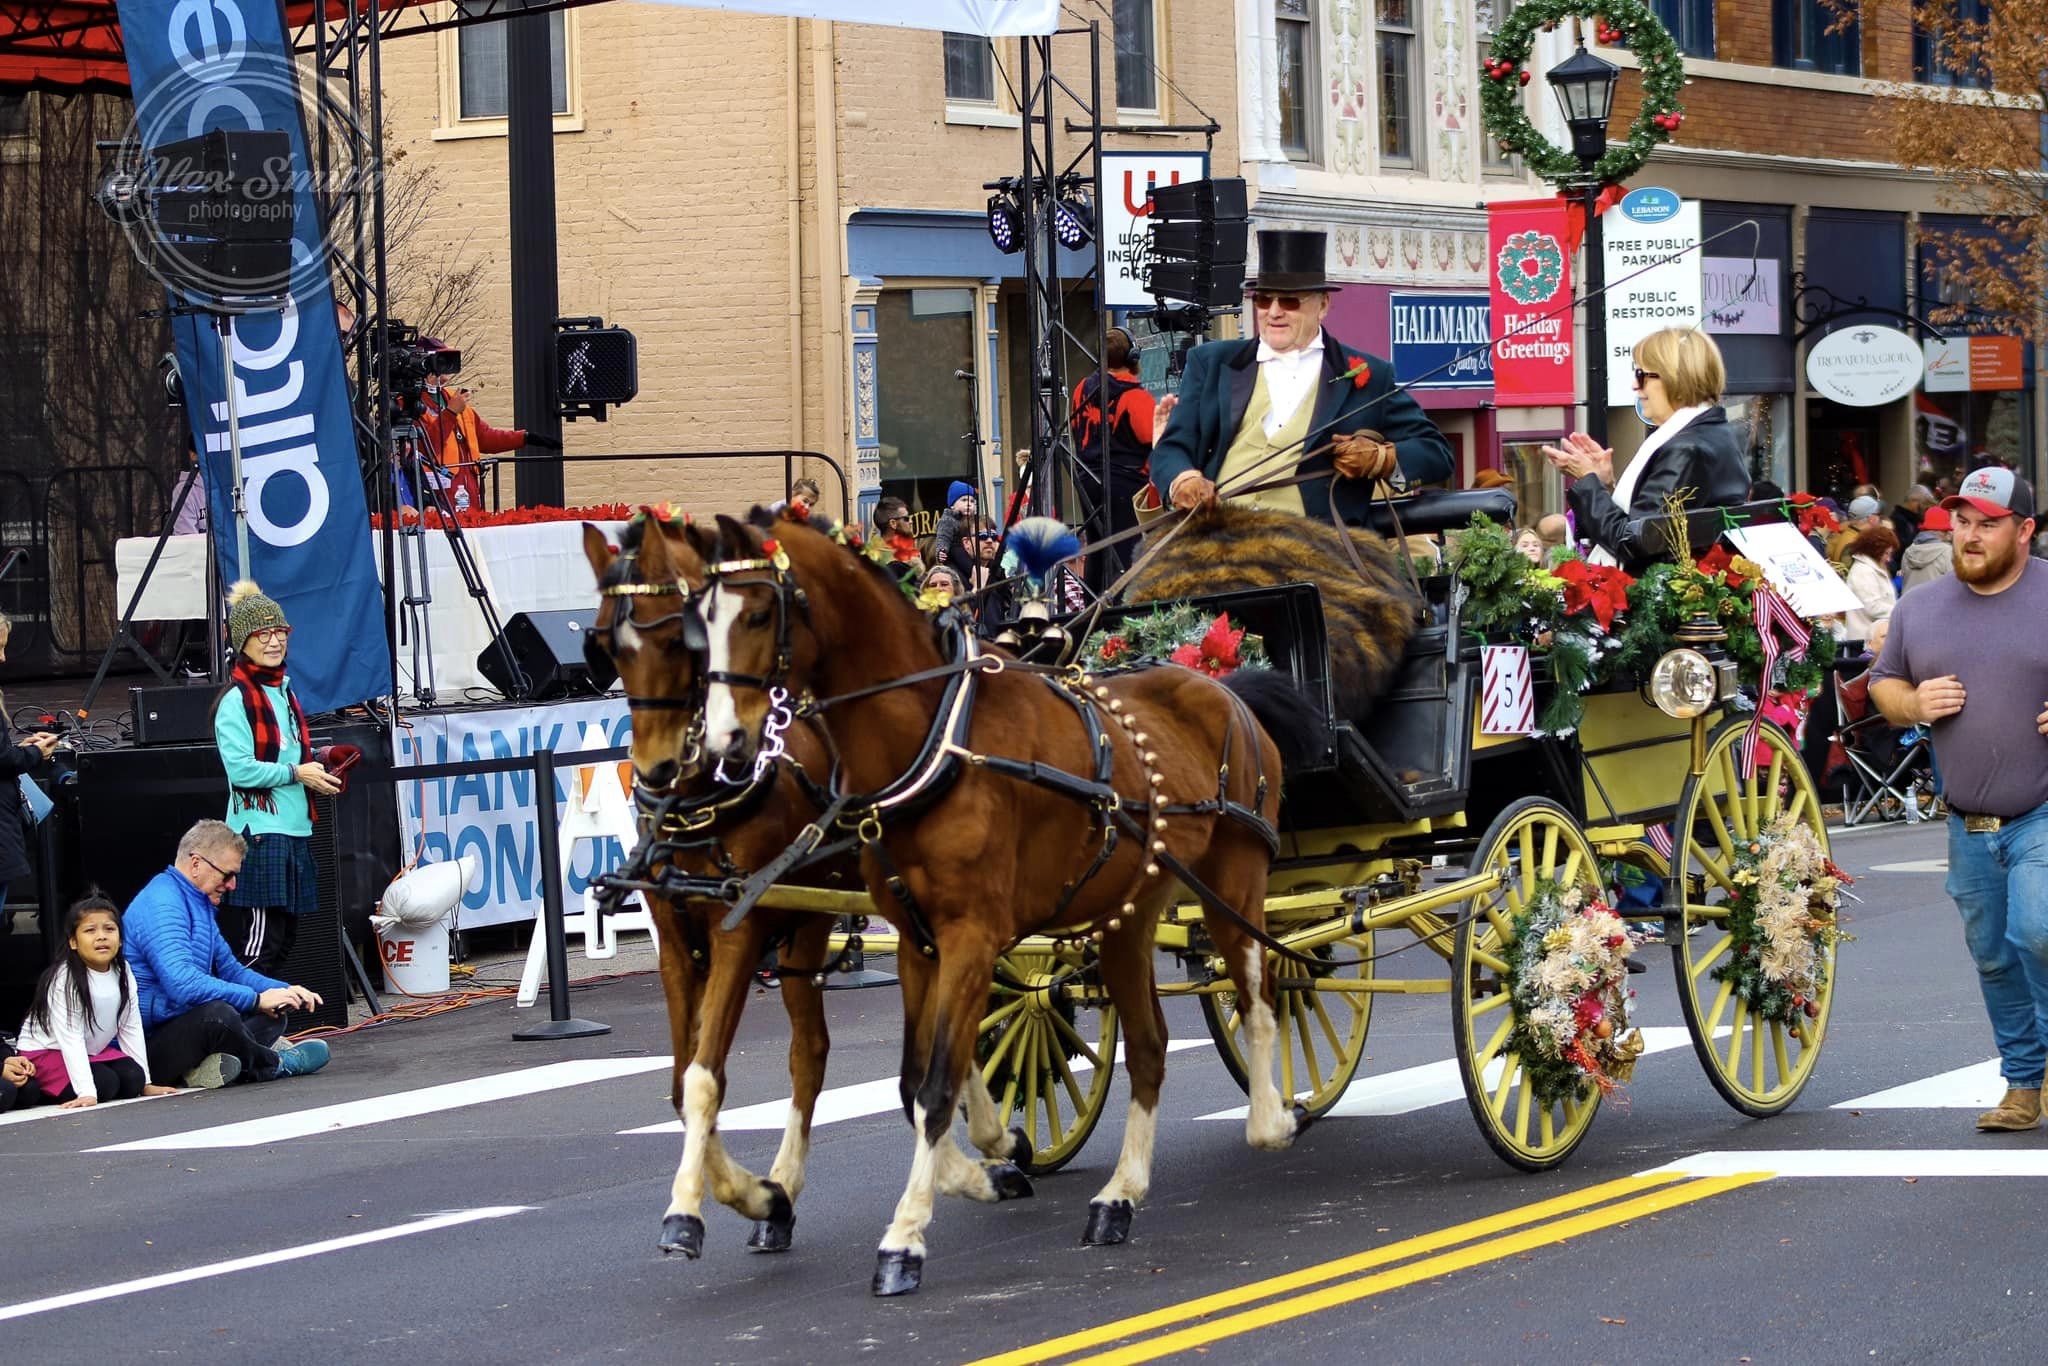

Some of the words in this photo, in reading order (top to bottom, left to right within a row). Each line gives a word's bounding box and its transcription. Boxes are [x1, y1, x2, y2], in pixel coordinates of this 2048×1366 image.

[1631, 206, 1670, 214] LEBANON
[1119, 233, 1154, 245] WAG
[1608, 241, 1642, 252] FREE
[1646, 238, 1694, 250] PUBLIC
[1622, 253, 1682, 266] PARKING
[1629, 291, 1677, 303] PUBLIC
[1612, 306, 1695, 319] RESTROOMS
[1503, 313, 1562, 341] Holiday
[1496, 336, 1571, 365] Greetings
[1613, 346, 1632, 357] SH
[909, 511, 941, 538] URA
[1504, 673, 1514, 709] 5
[383, 940, 415, 962] CE
